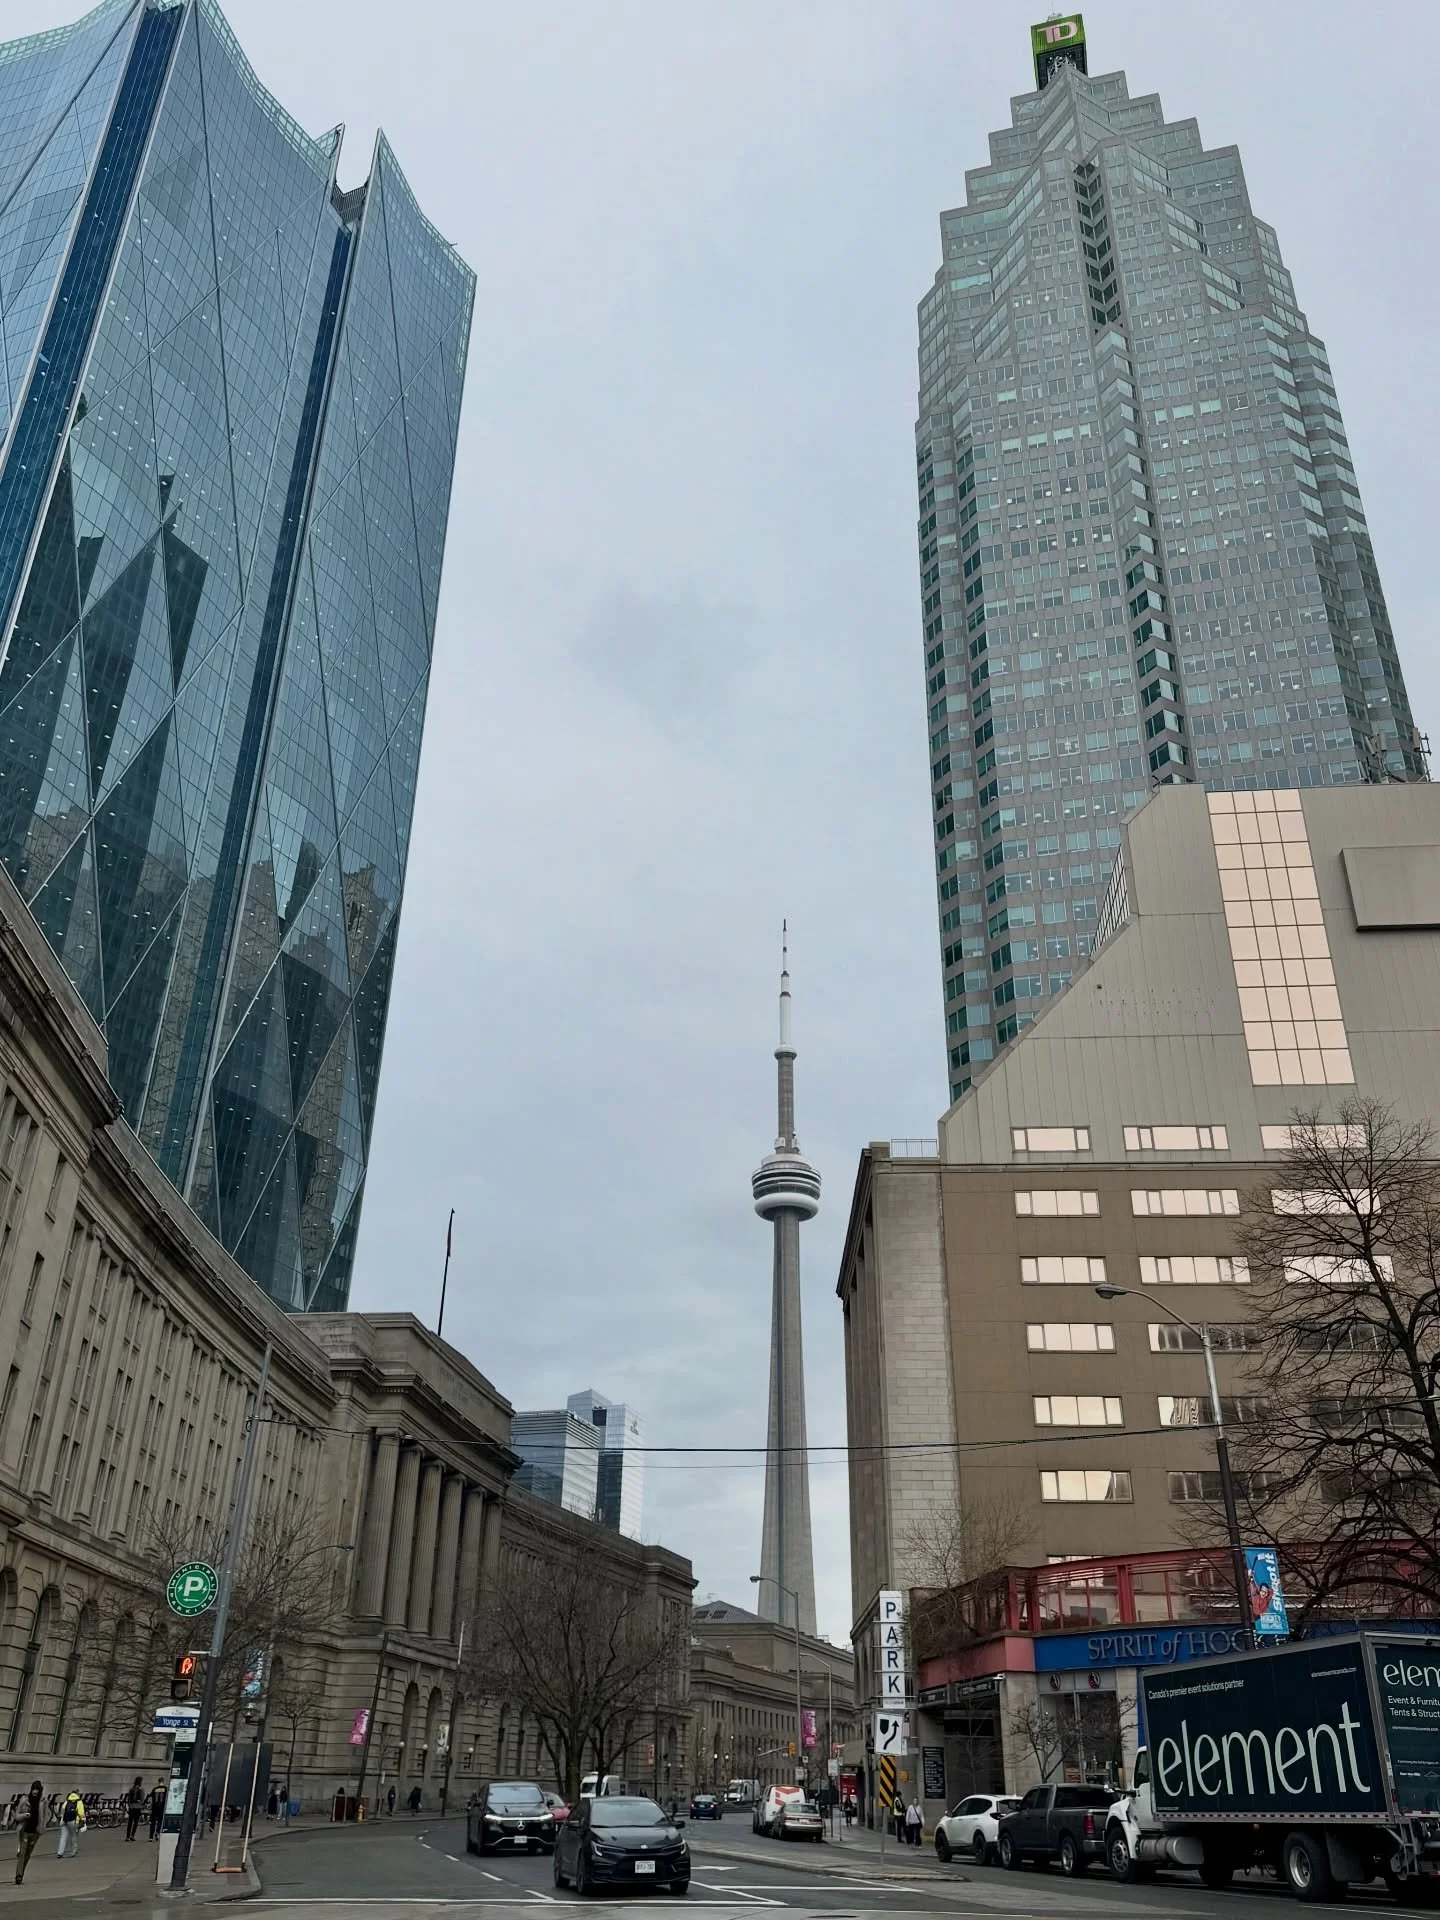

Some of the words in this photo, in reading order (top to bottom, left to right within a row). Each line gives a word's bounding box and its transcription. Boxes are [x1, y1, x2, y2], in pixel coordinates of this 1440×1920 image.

[1037, 21, 1078, 44] TD
[171, 1565, 216, 1588] MUNICIPAL
[183, 1576, 204, 1597] P
[170, 1591, 213, 1613] PARKING
[885, 1601, 900, 1693] PARK
[1088, 1634, 1157, 1660] SPIRIT
[1160, 1632, 1182, 1664] of
[1148, 1688, 1170, 1700] Canada's
[1170, 1685, 1187, 1698] premier
[1188, 1684, 1202, 1694] event
[1202, 1682, 1225, 1692] solutions
[1225, 1679, 1244, 1691] partner
[1388, 1695, 1409, 1705] Event
[1410, 1696, 1416, 1705] &
[163, 1717, 181, 1727] Yonge
[183, 1719, 189, 1727] St
[1389, 1707, 1410, 1717] Tents
[1411, 1708, 1417, 1717] &
[1158, 1702, 1370, 1797] element
